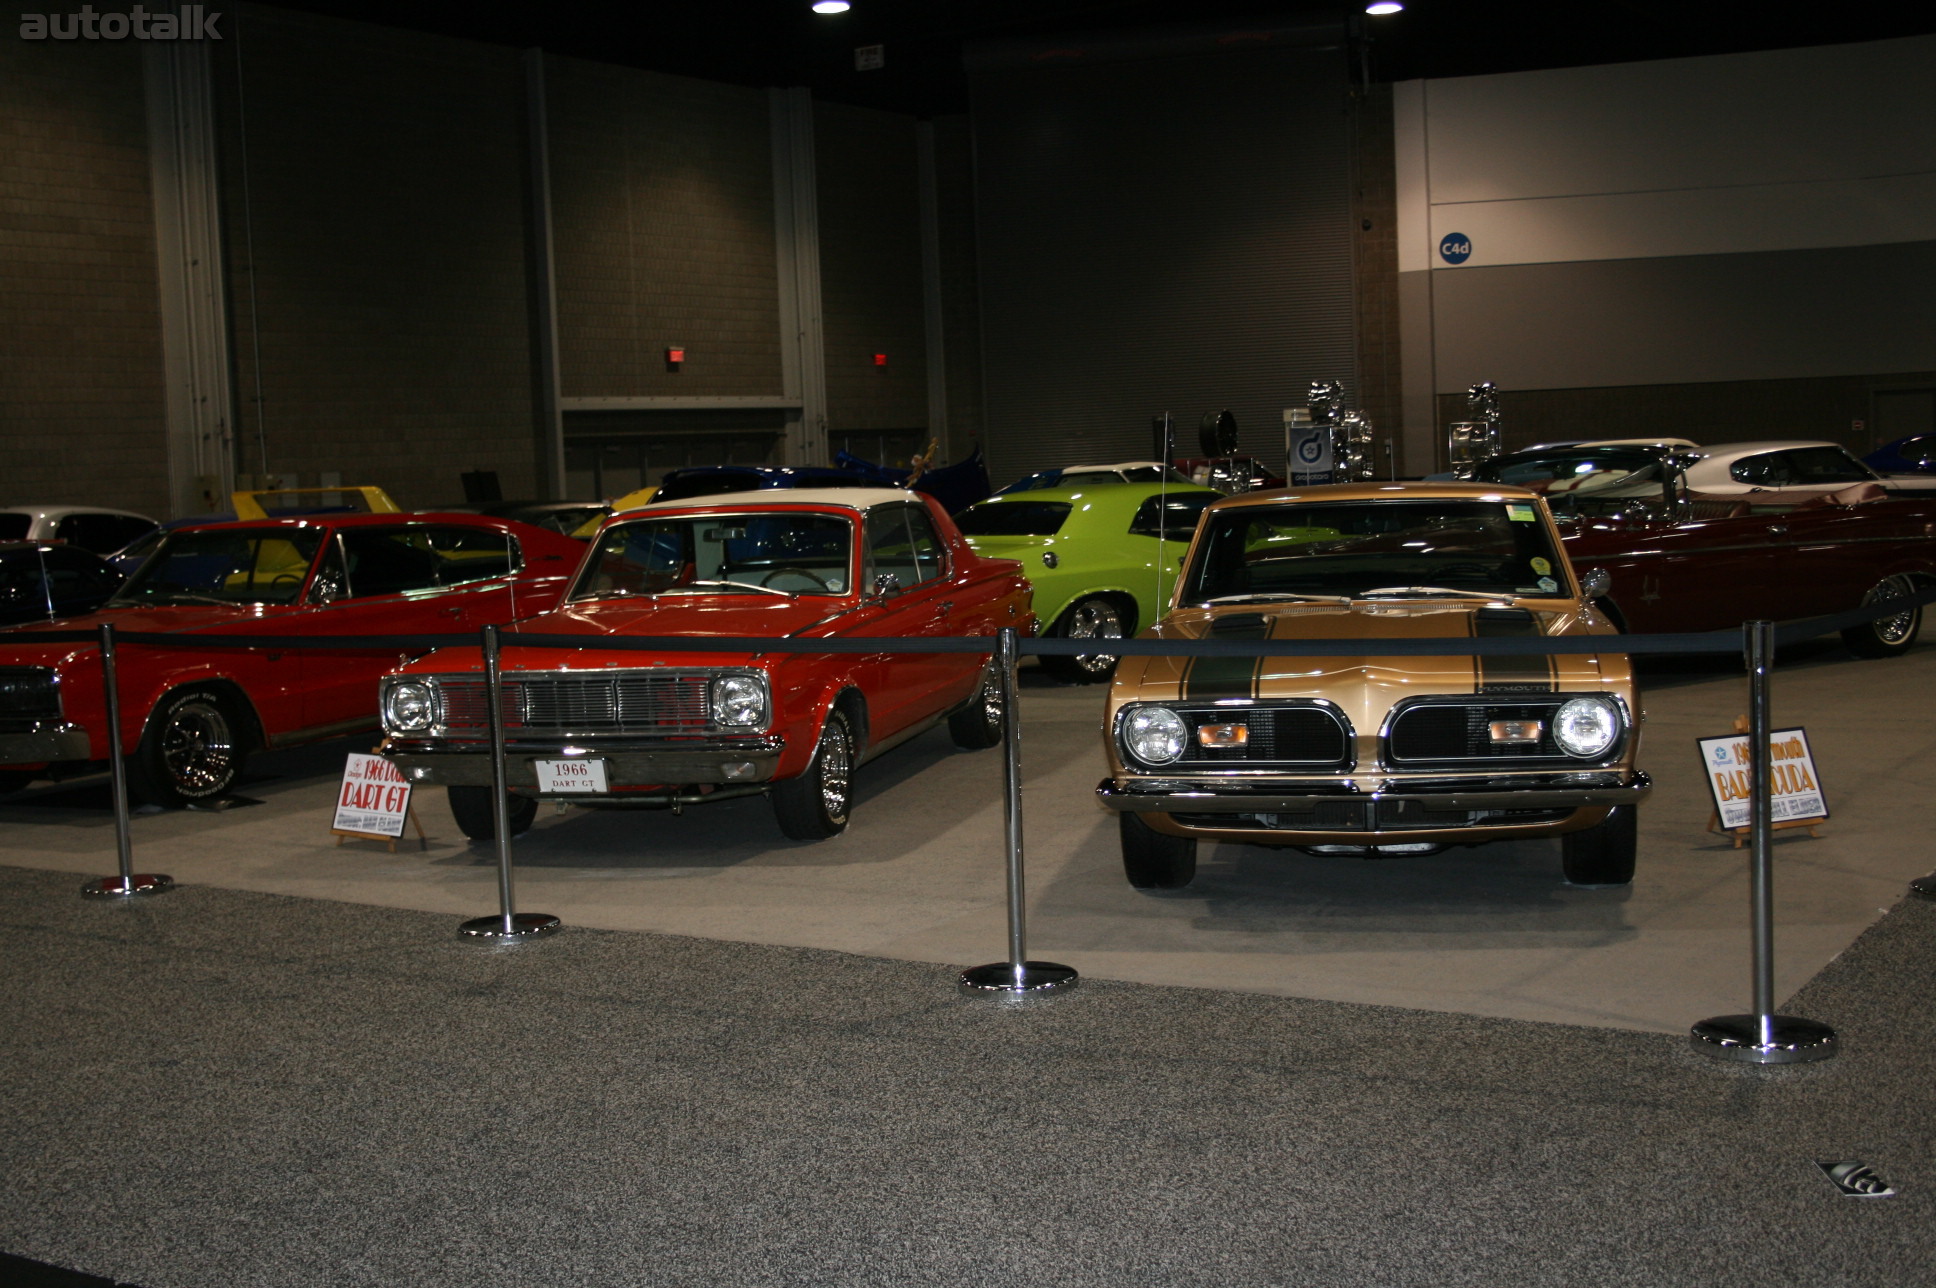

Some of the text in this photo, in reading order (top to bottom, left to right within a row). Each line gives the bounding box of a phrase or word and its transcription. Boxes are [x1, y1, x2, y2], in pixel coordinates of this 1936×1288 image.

[1442, 242, 1470, 255] C4d
[364, 759, 386, 781] 1966
[555, 763, 588, 777] 1966
[552, 780, 595, 788] DART GT
[341, 781, 409, 813] DART GT
